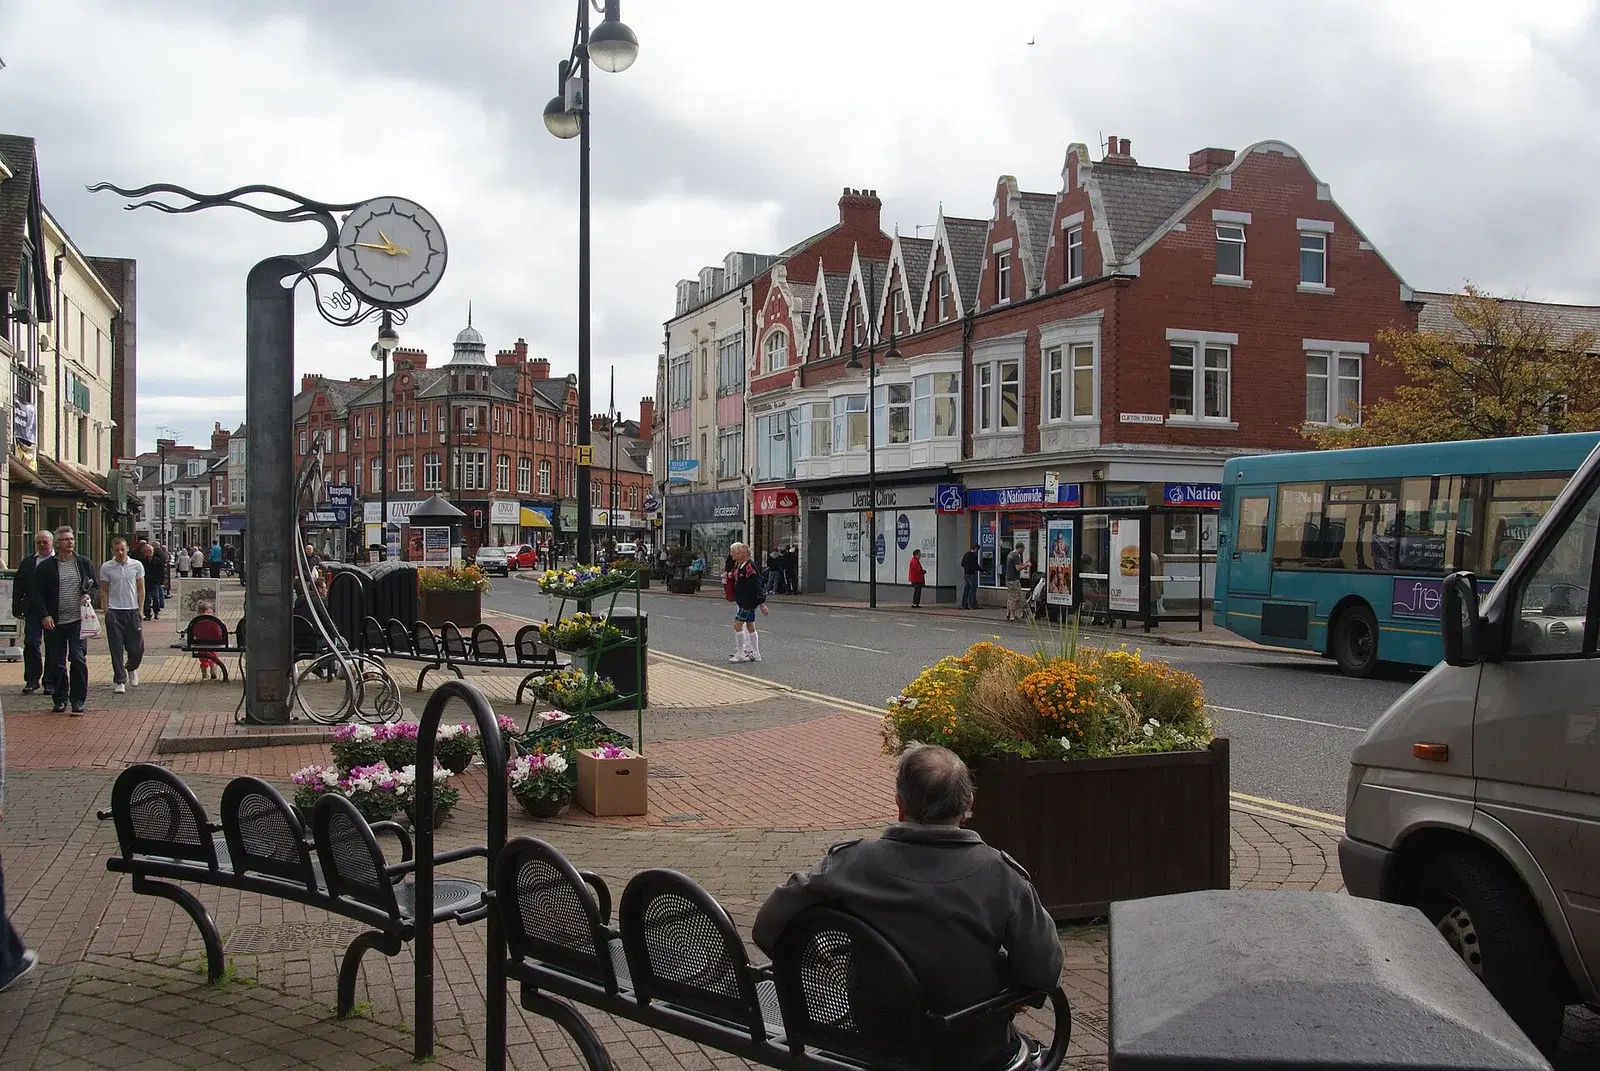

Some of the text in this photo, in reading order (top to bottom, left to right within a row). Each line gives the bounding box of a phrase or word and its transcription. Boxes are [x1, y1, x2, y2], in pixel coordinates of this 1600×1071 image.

[852, 489, 897, 507] Denta Clinic
[1006, 489, 1042, 504] Nationwide
[982, 533, 995, 544] CASH
[1397, 582, 1443, 611] fre
